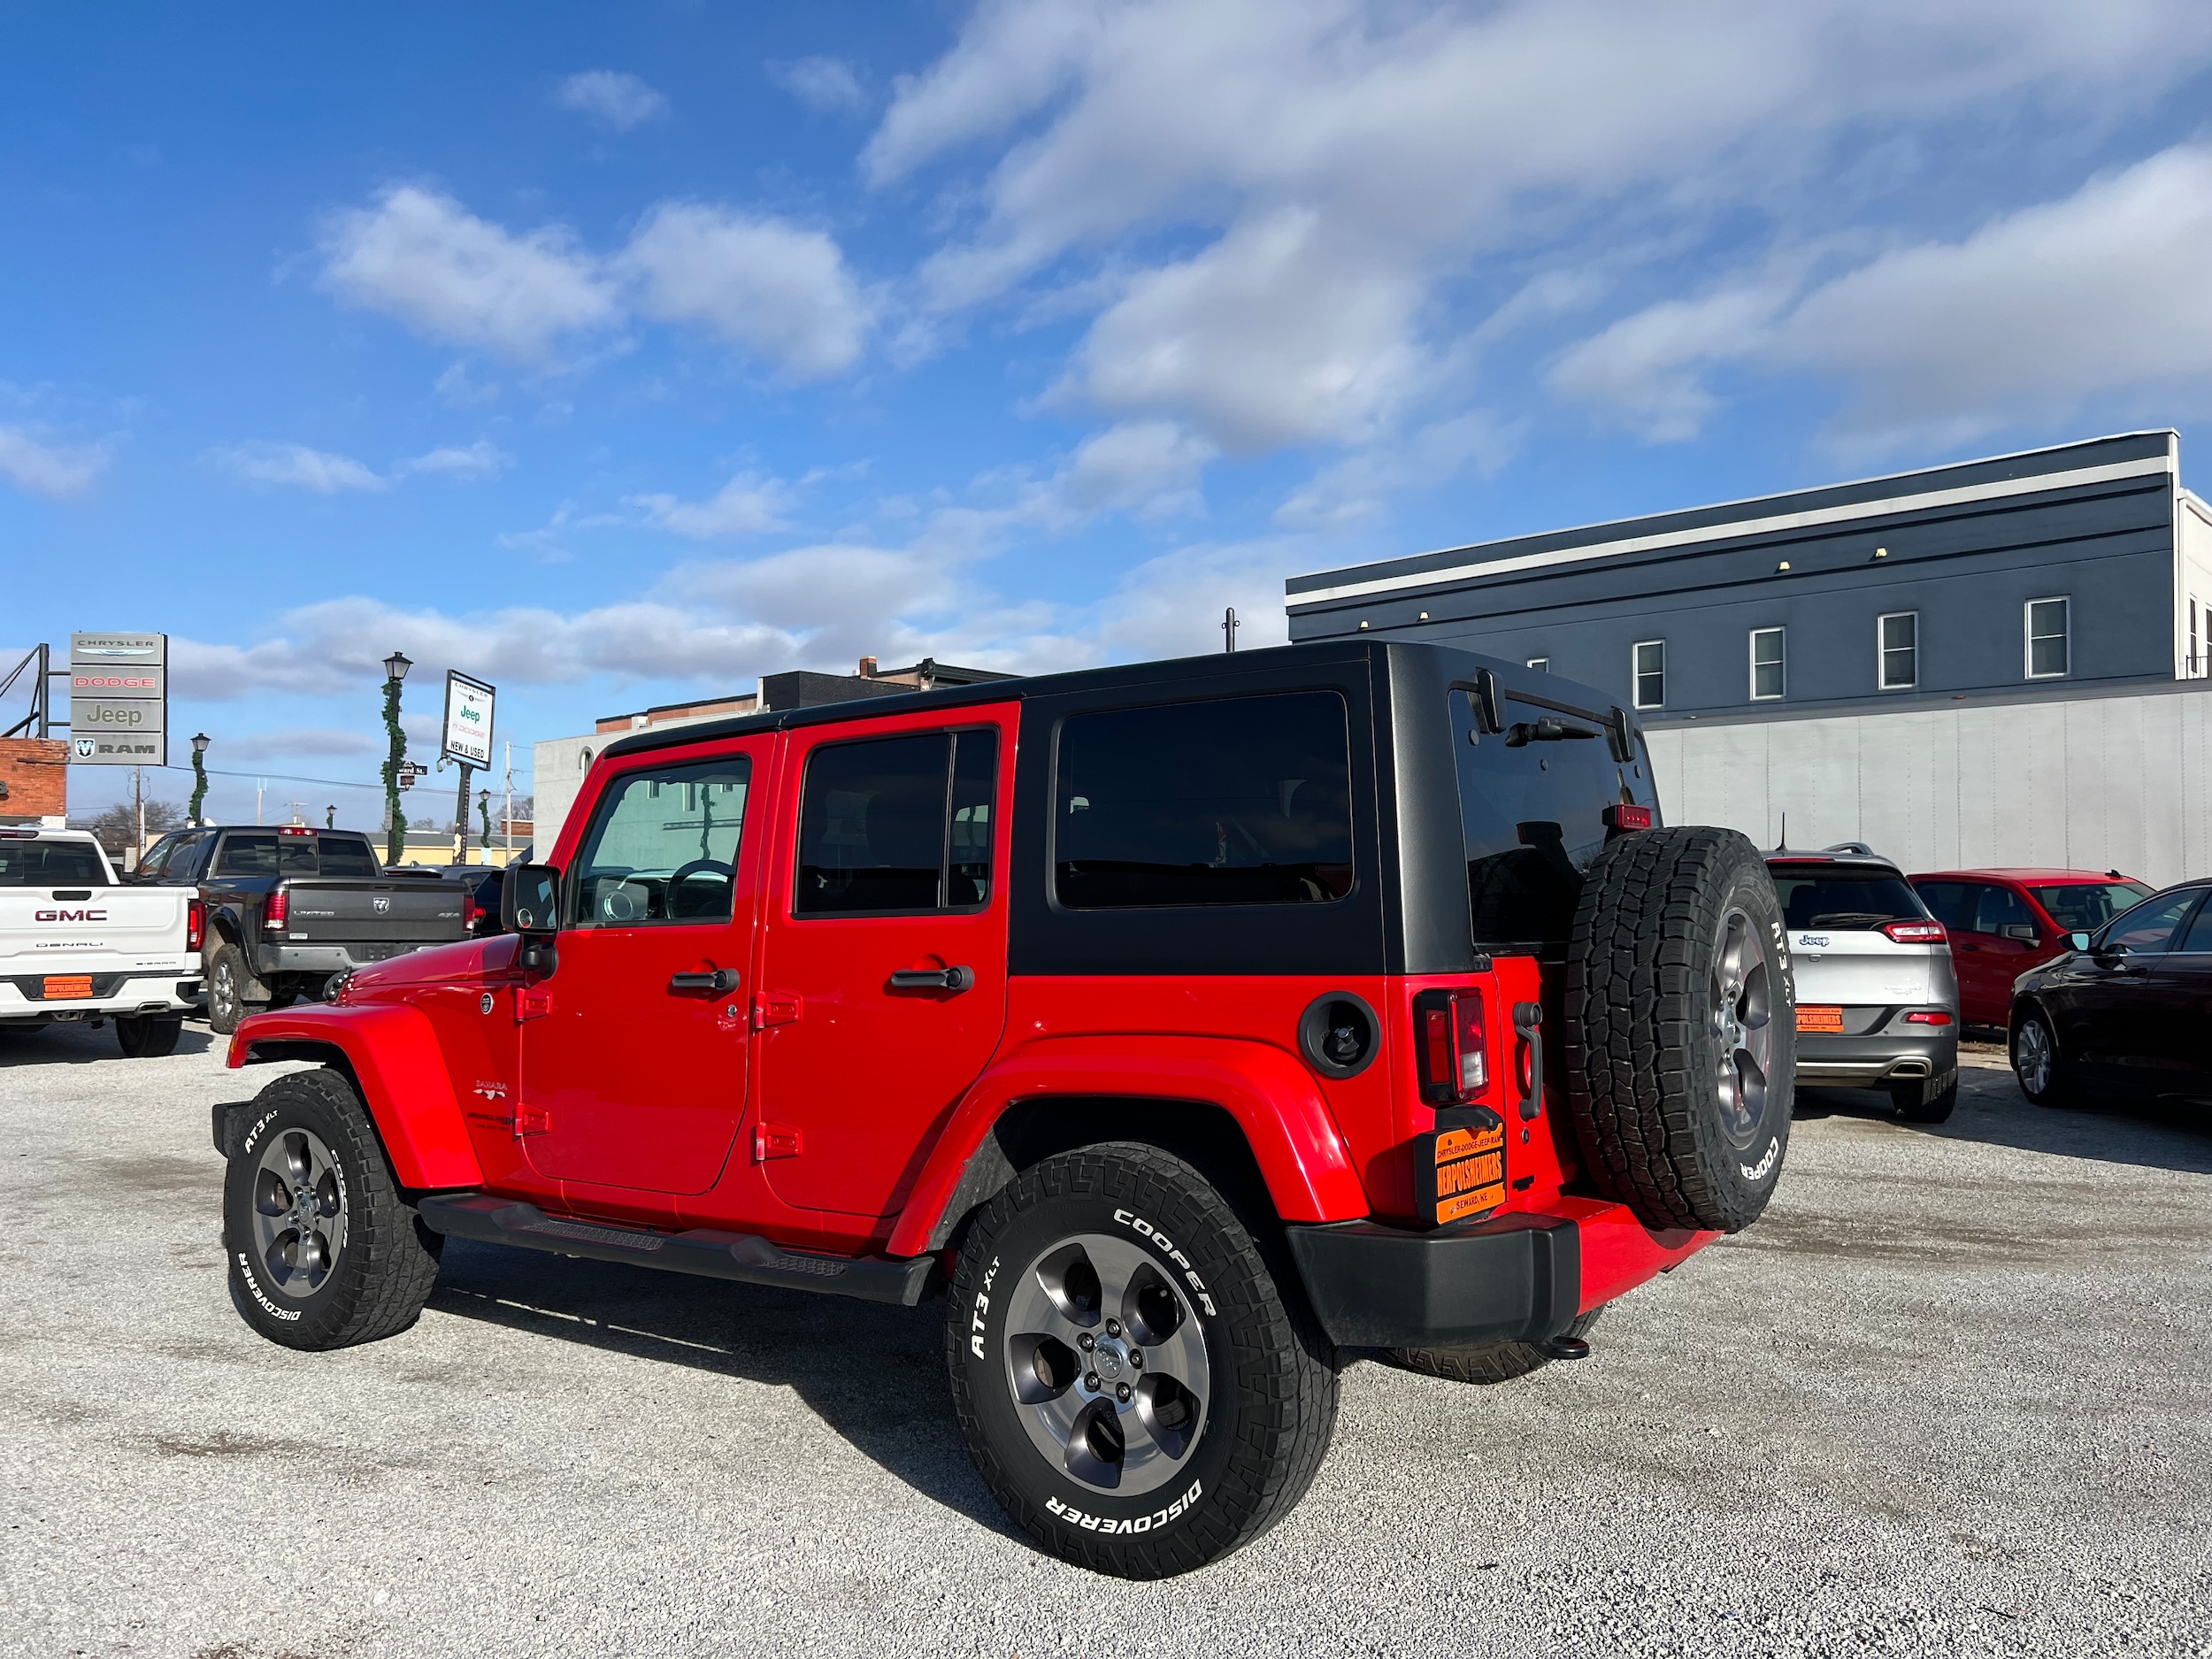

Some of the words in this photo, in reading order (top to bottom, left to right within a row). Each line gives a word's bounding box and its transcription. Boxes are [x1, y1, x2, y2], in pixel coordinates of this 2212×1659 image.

[74, 677, 156, 688] DODGE
[454, 681, 488, 698] CHRYSLER
[86, 704, 143, 727] Jeep
[460, 705, 480, 724] Jeep
[458, 725, 486, 739] DODGE
[98, 744, 156, 755] RAM
[450, 740, 464, 753] NEW
[464, 744, 469, 755] &
[470, 747, 485, 759] USED
[35, 910, 108, 922] GMC
[1799, 934, 1831, 948] Jeep
[1770, 921, 1788, 971] AT3
[1782, 975, 1792, 1008] XLT
[475, 1079, 508, 1090] SAHARA
[244, 1120, 266, 1155] AT3
[265, 1109, 279, 1125] XLT
[1740, 1135, 1779, 1181] COOPER
[1437, 1151, 1502, 1197] HERPOLSHEIMERS
[1480, 1193, 1488, 1202] NE
[1113, 1208, 1217, 1317] COOPER
[237, 1252, 302, 1322] DISCOVERER
[970, 1291, 990, 1361] AT3
[983, 1256, 1002, 1292] XLT
[1044, 1478, 1203, 1535] DISCOVERER
